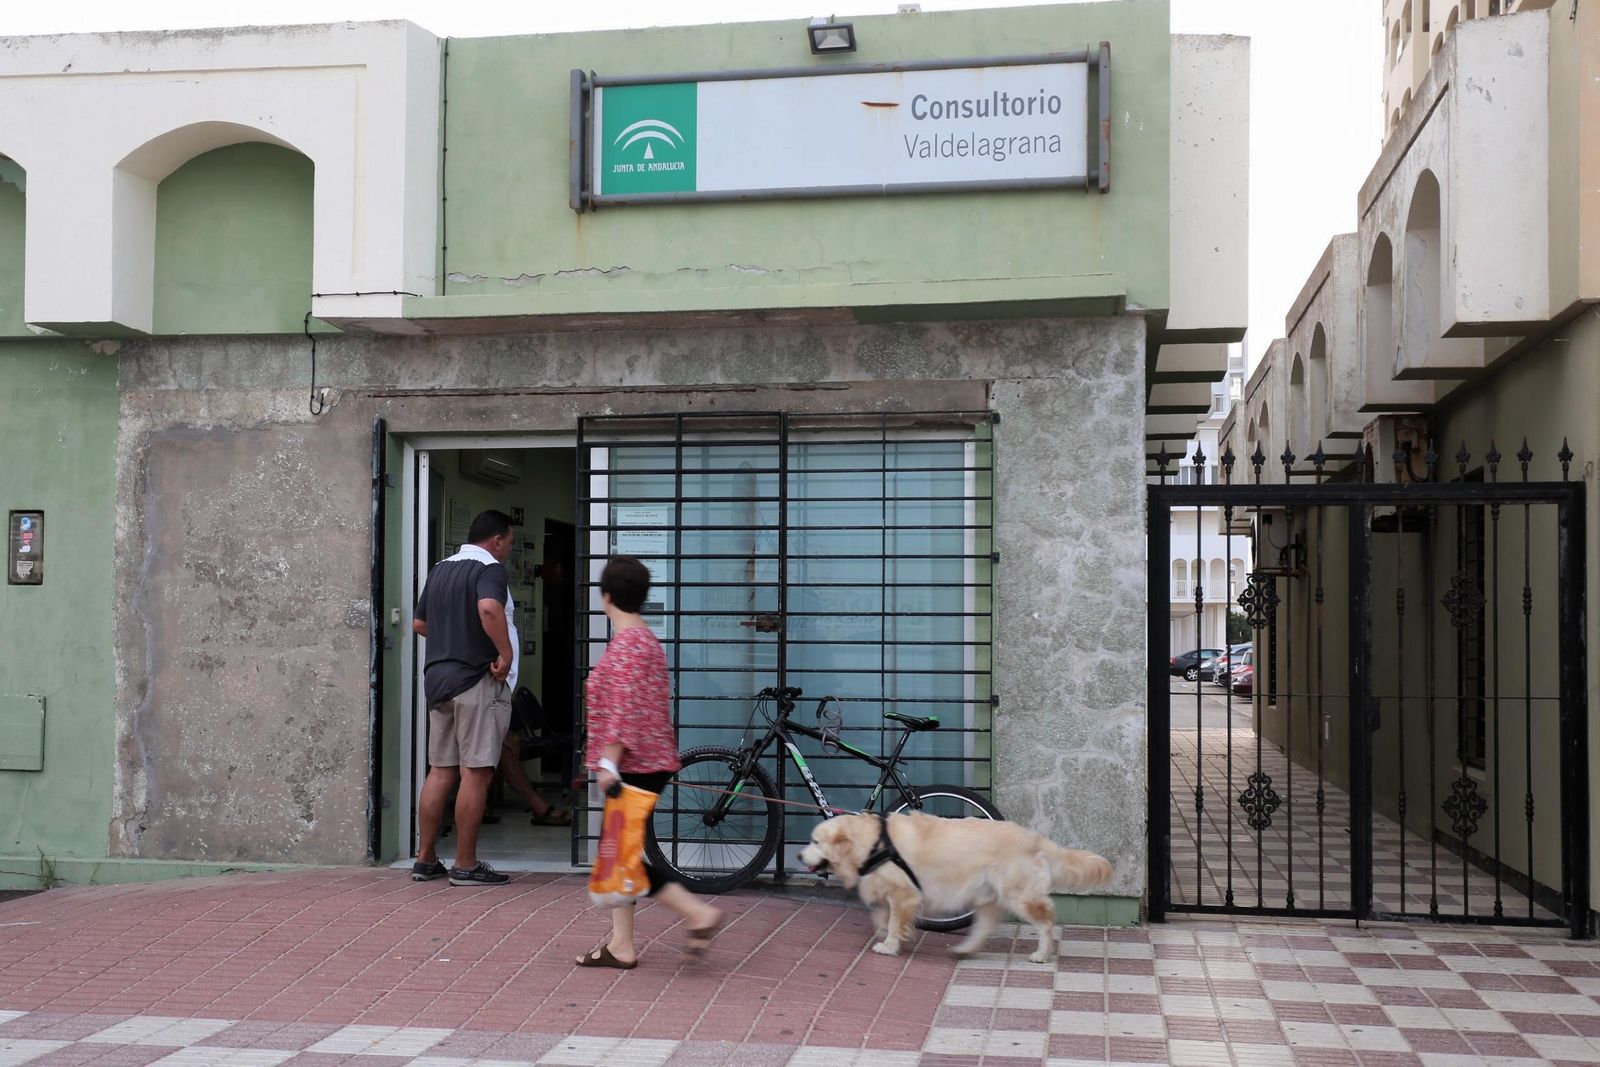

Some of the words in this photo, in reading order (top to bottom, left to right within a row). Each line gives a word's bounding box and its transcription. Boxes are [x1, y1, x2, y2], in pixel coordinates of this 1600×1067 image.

[911, 88, 1062, 120] Consultorio
[904, 131, 1062, 162] Valdelagrana
[612, 163, 634, 173] JUNTA
[637, 163, 646, 172] DE
[648, 161, 685, 171] ANDALUCIA
